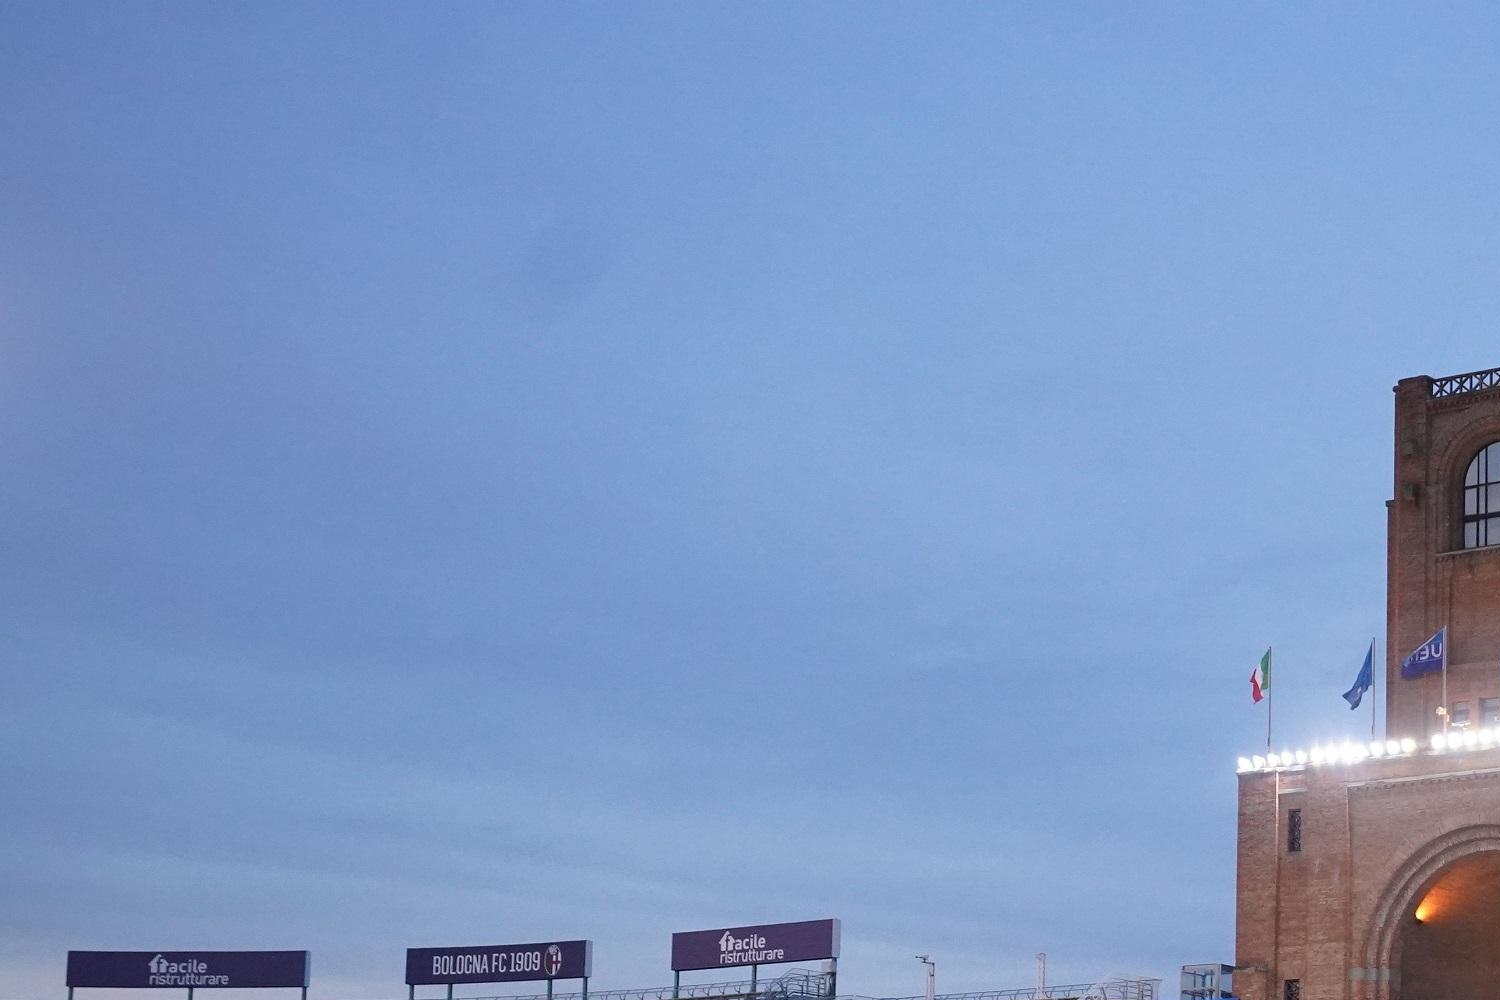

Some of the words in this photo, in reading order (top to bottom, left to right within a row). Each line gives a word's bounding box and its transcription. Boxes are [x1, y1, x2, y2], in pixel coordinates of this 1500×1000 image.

[432, 954, 489, 975] BOLOGNA
[492, 954, 507, 973] FC
[509, 951, 541, 973] 1909
[720, 948, 784, 964] ristrutturare
[149, 973, 229, 986] ristrutturare
